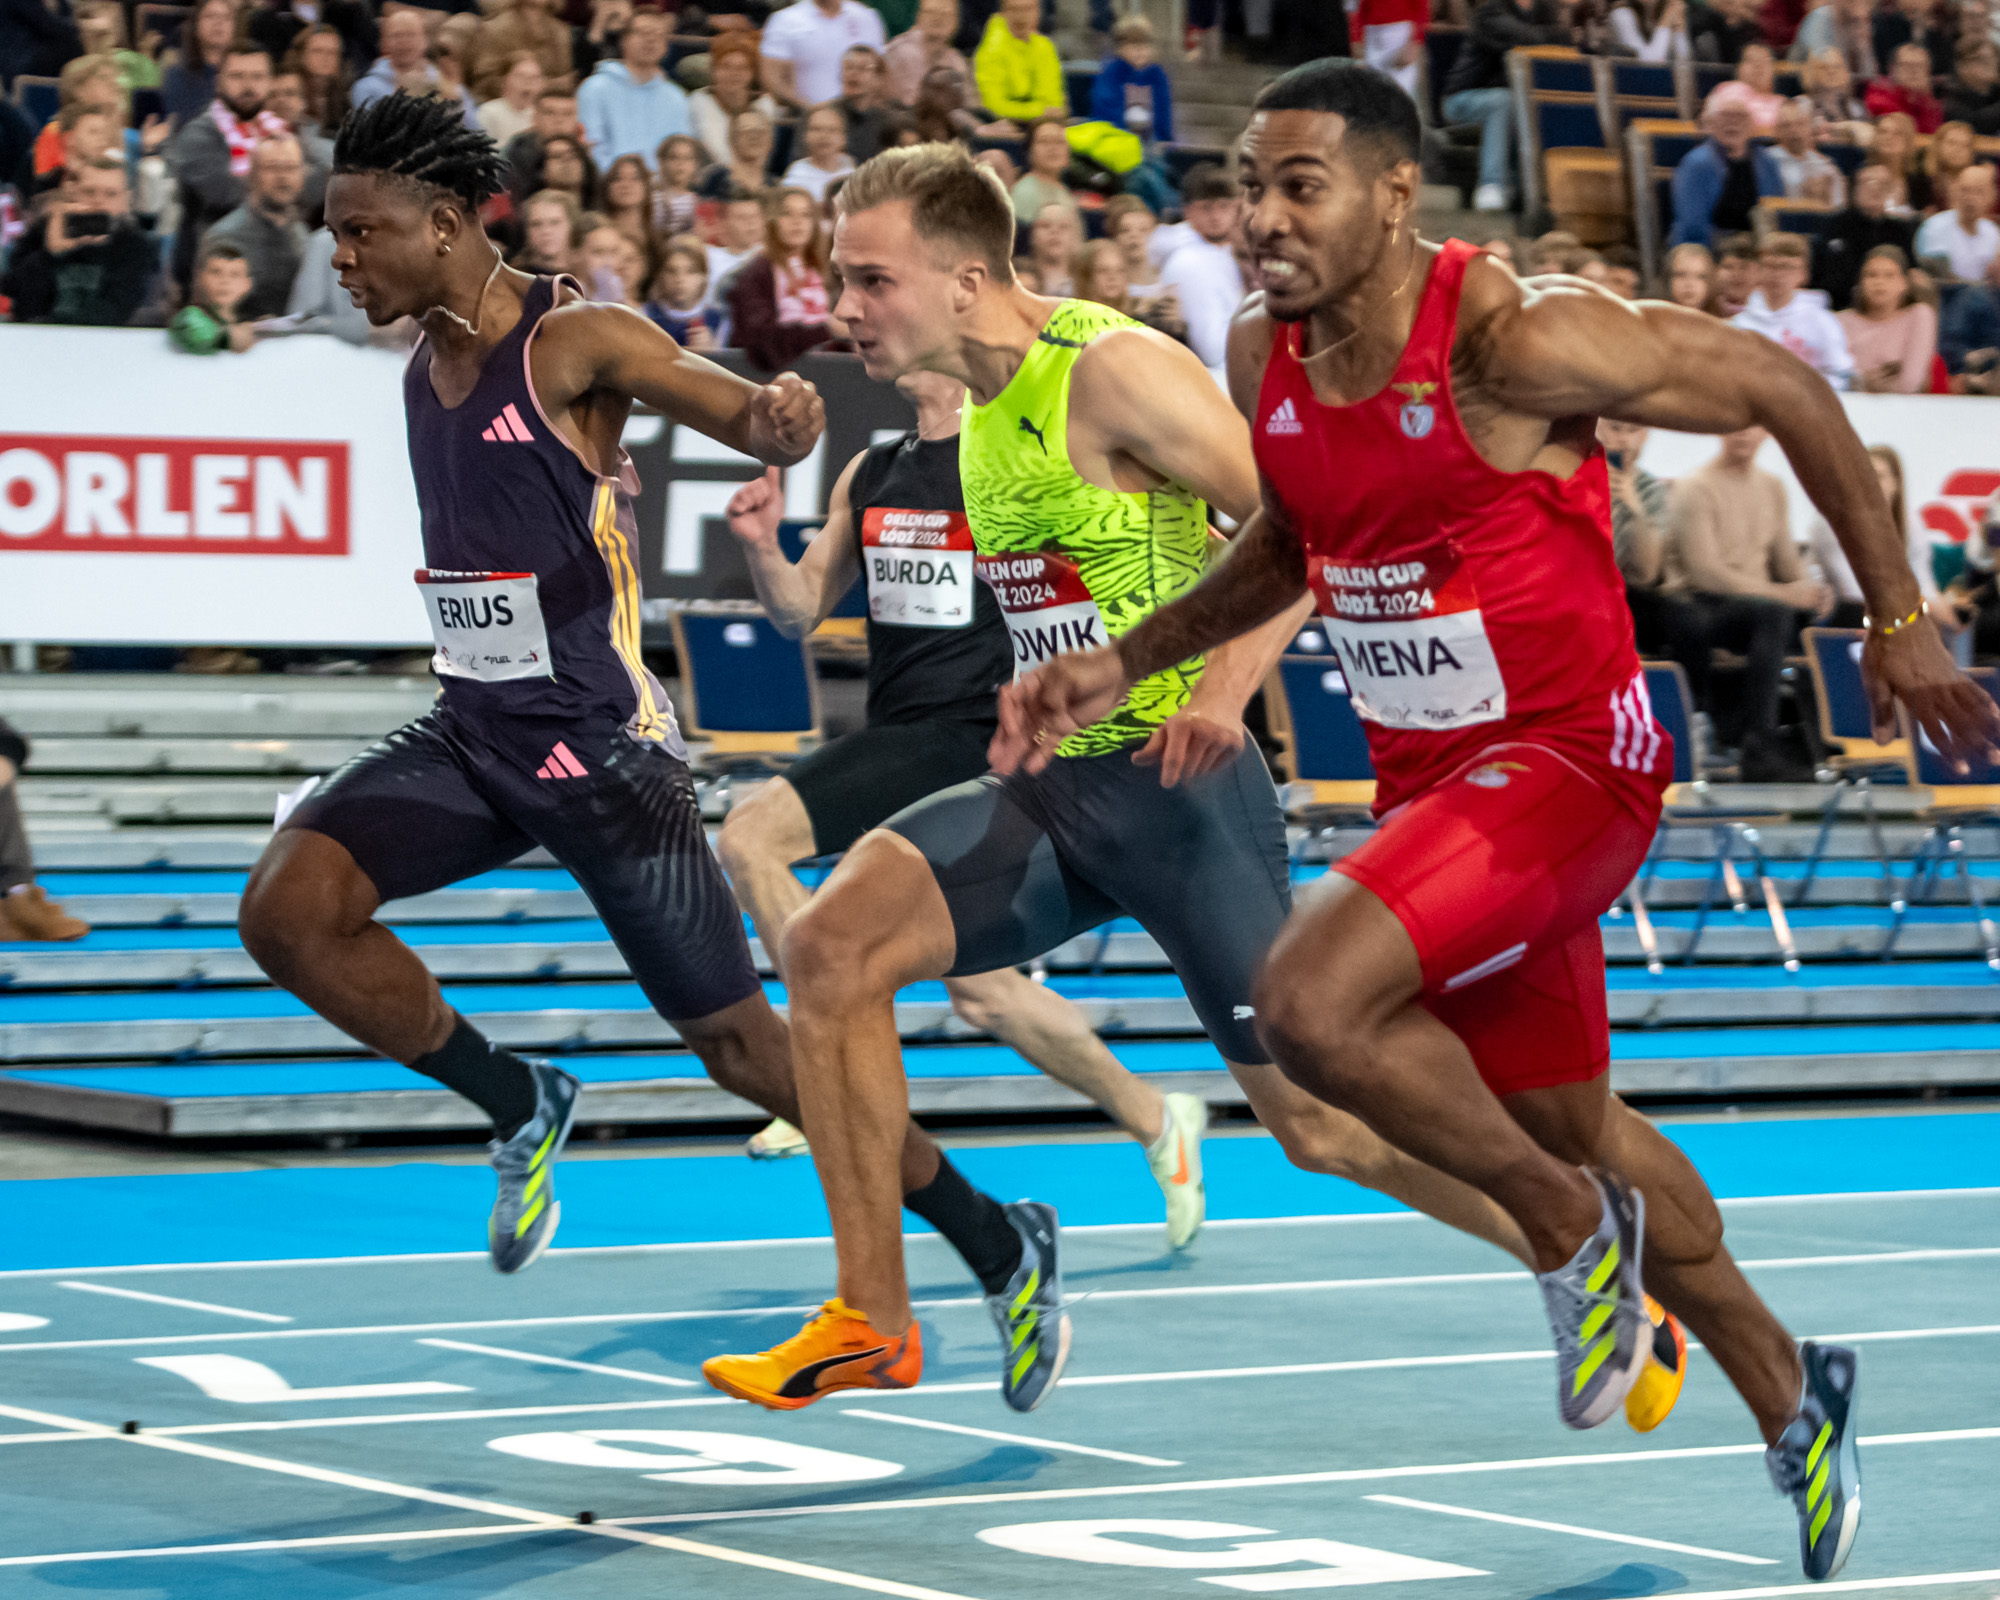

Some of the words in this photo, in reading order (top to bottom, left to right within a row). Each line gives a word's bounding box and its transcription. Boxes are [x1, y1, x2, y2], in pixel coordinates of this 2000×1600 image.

[0, 447, 331, 541] ORLEN
[883, 512, 924, 526] ORLEN
[924, 514, 951, 528] CUP
[916, 531, 948, 546] 2024
[874, 558, 957, 585] BURDA
[1011, 558, 1045, 579] CUP
[1323, 564, 1378, 587] ORLEN
[1378, 561, 1426, 587] CUP
[1011, 582, 1057, 606] 2024
[1380, 587, 1436, 614] 2024
[437, 594, 514, 629] ERIUS
[1012, 616, 1099, 662] OWIK
[1342, 636, 1464, 677] MENA
